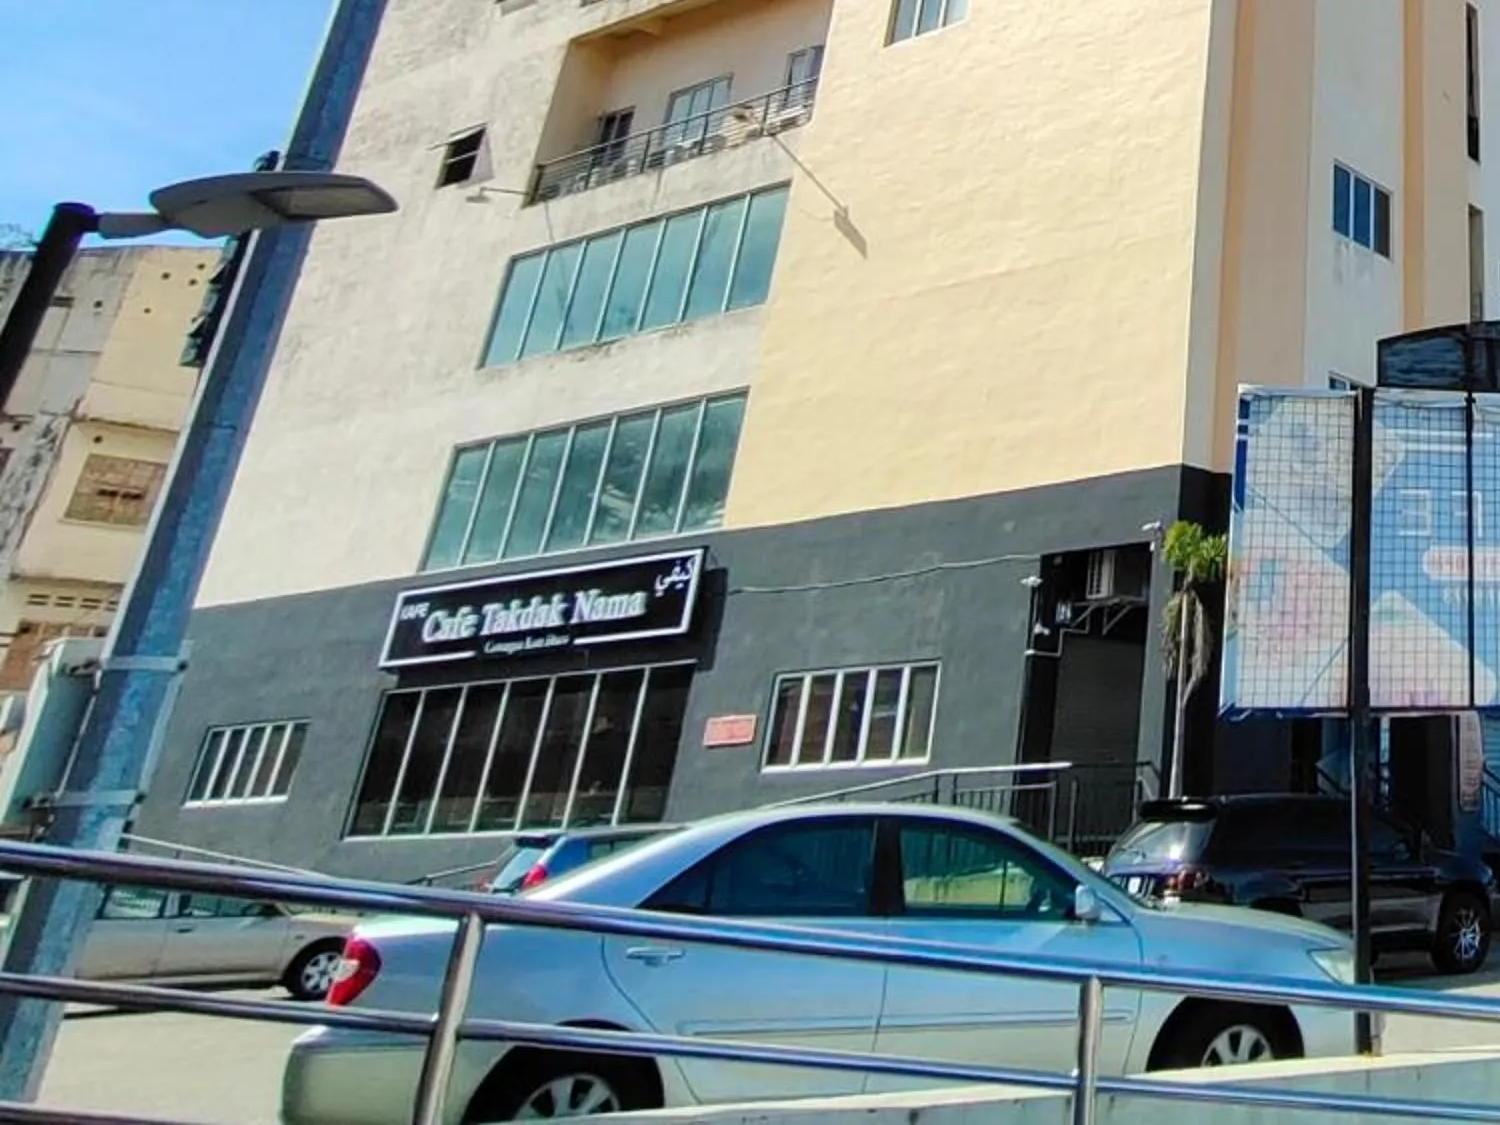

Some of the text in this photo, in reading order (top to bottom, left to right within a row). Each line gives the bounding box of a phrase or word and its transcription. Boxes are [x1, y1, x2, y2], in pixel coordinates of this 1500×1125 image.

[422, 588, 648, 643] Cafe Takdak Nama
